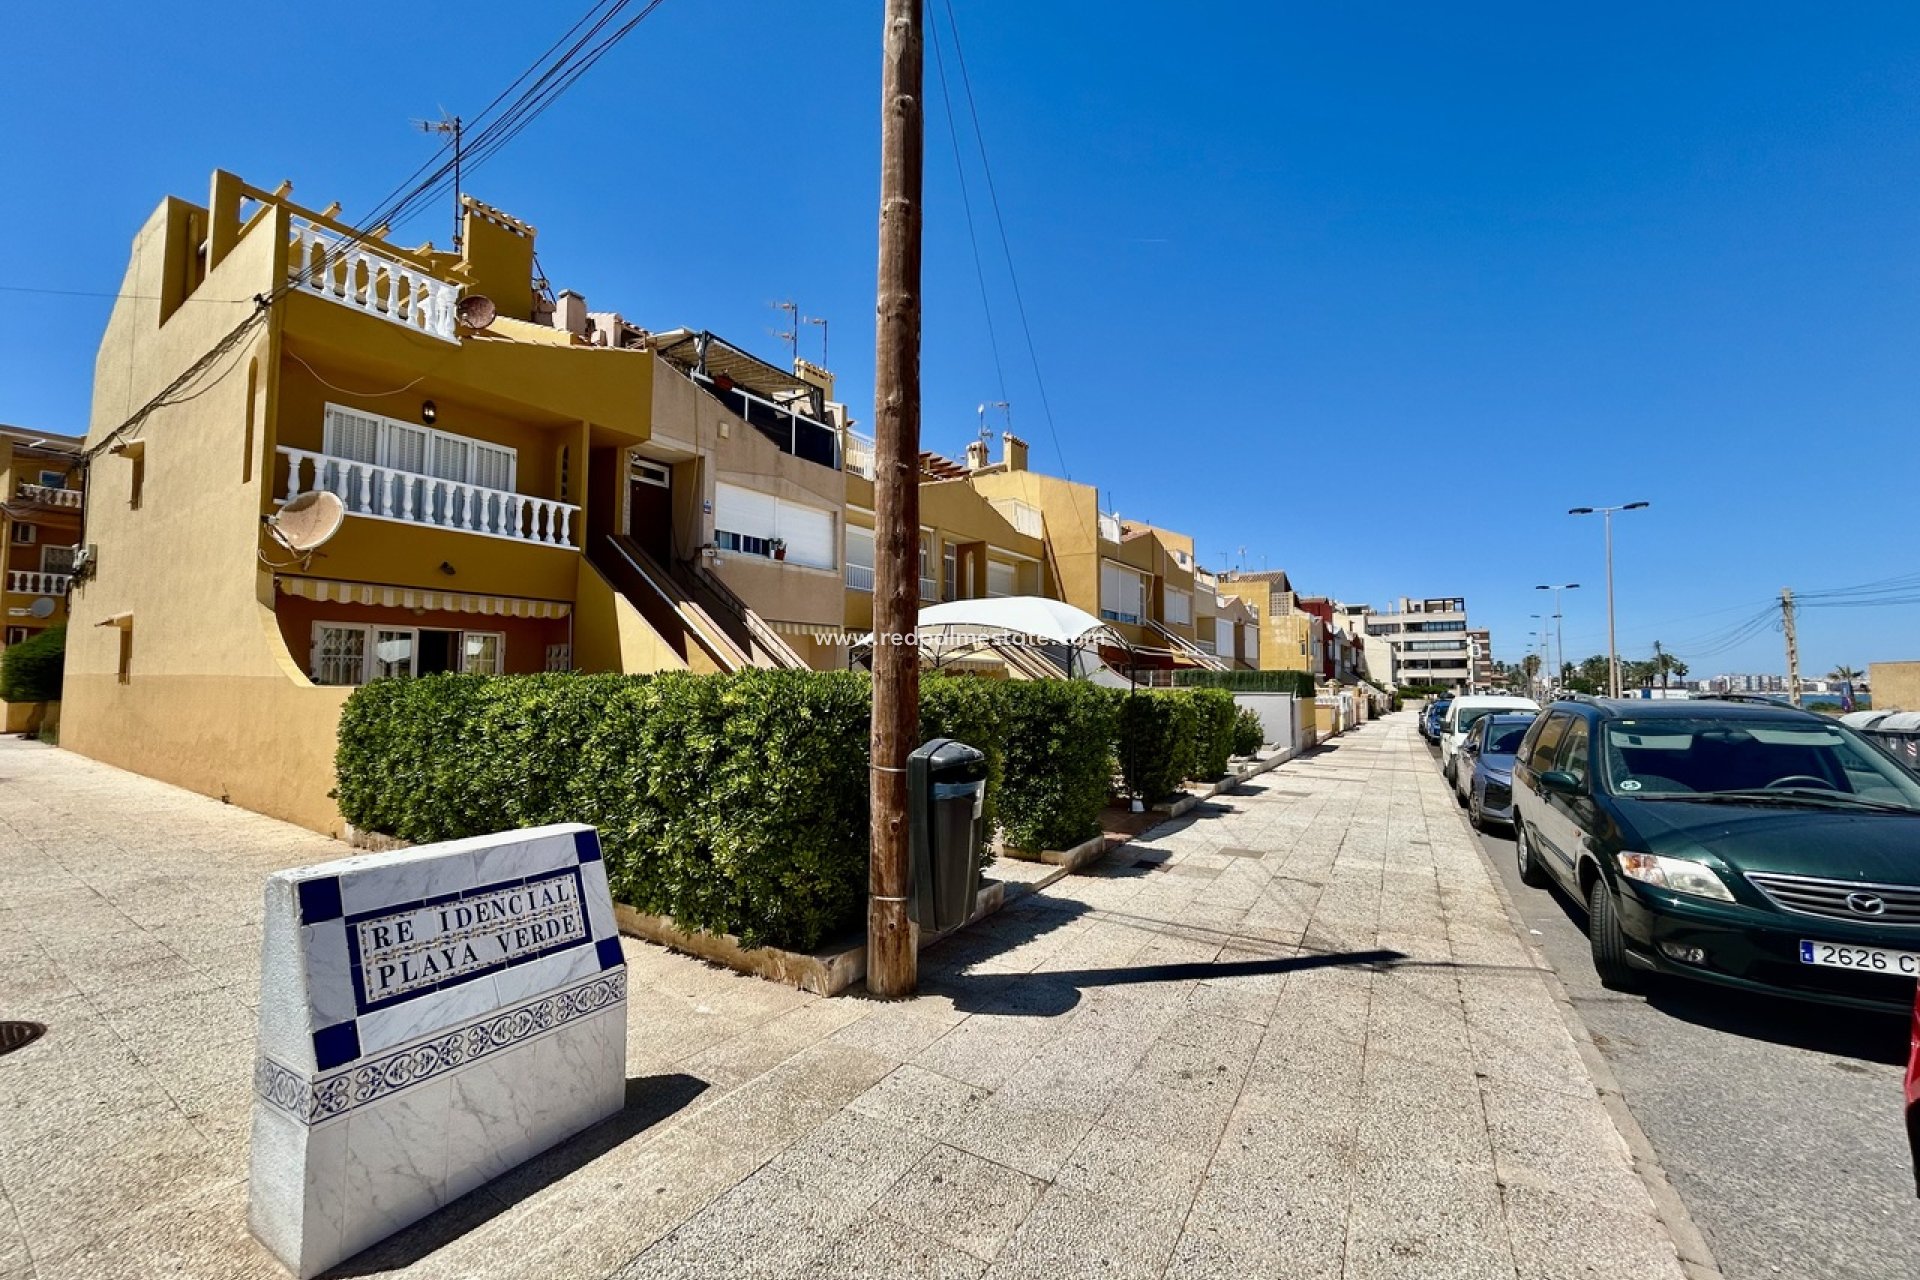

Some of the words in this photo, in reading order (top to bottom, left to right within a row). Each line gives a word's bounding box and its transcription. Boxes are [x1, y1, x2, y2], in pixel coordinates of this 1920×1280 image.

[378, 942, 480, 990] PLAYA
[496, 914, 577, 954] VERDE
[1821, 945, 1888, 970] 2626
